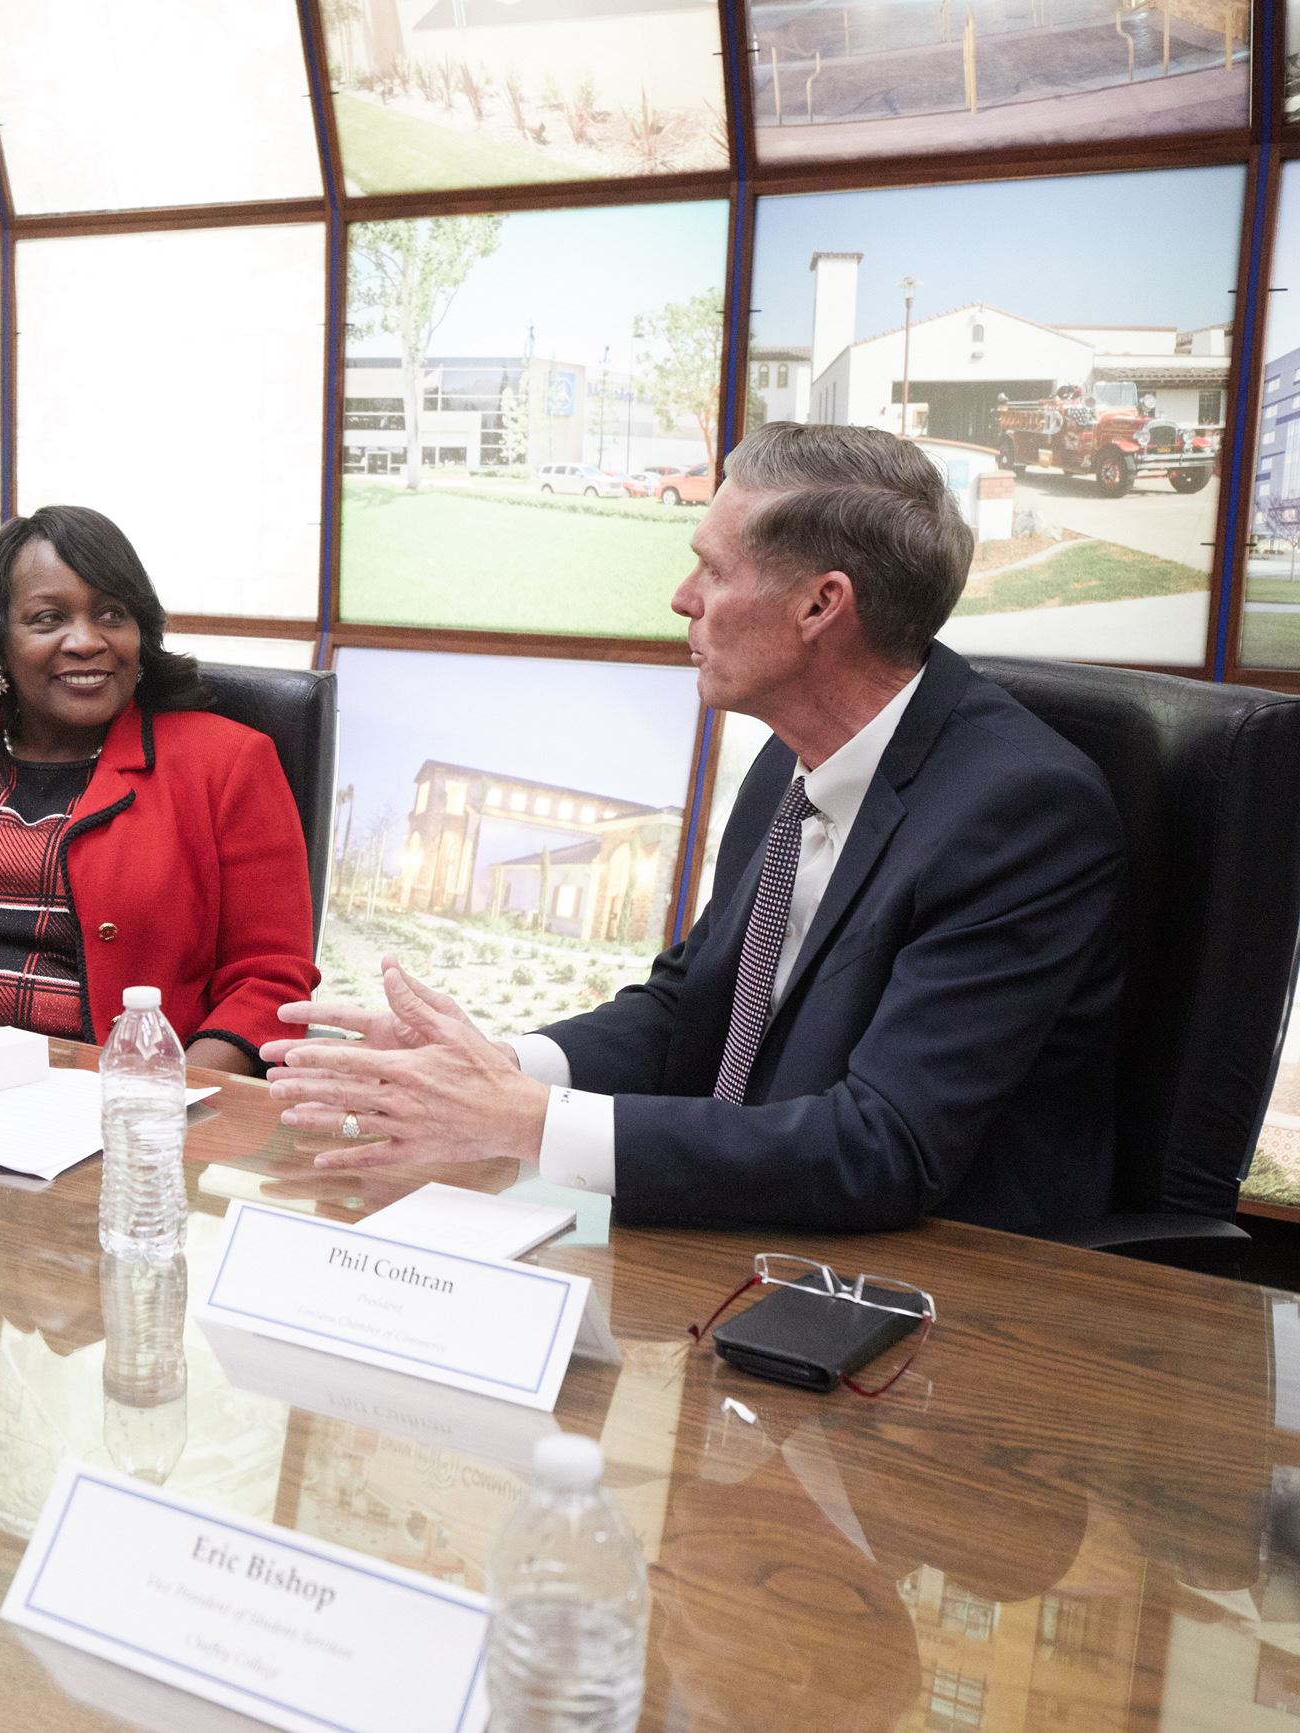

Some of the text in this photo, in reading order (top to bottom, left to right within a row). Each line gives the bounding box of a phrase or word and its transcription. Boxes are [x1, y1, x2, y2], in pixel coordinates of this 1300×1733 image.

[329, 1247, 454, 1294] Phil Cothran
[191, 1535, 336, 1613] Eric Bishop
